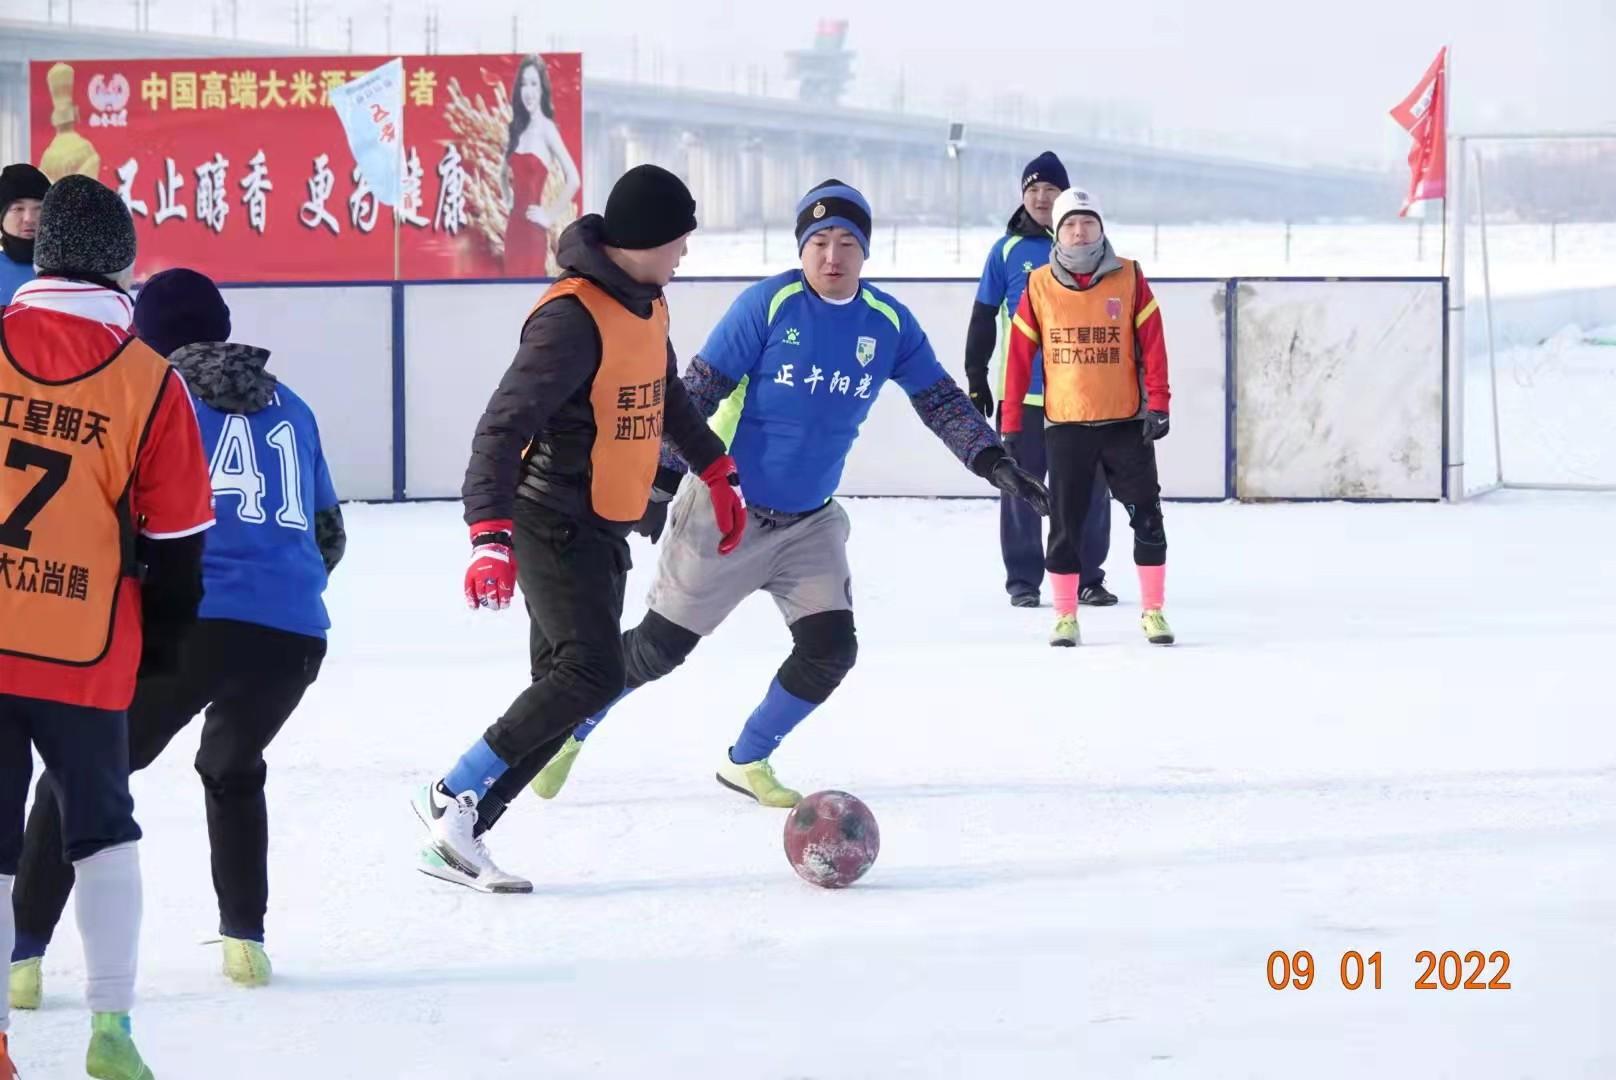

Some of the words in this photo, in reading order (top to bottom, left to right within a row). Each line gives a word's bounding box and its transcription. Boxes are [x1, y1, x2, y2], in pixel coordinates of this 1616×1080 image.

[141, 67, 437, 111] 中国高端大米酒者
[1050, 326, 1121, 344] 军工星期天
[617, 377, 665, 411] 军工星
[774, 363, 873, 399] 正午阳光
[0, 392, 111, 449] 工星期天
[209, 413, 308, 531] 41
[0, 438, 73, 551] 7
